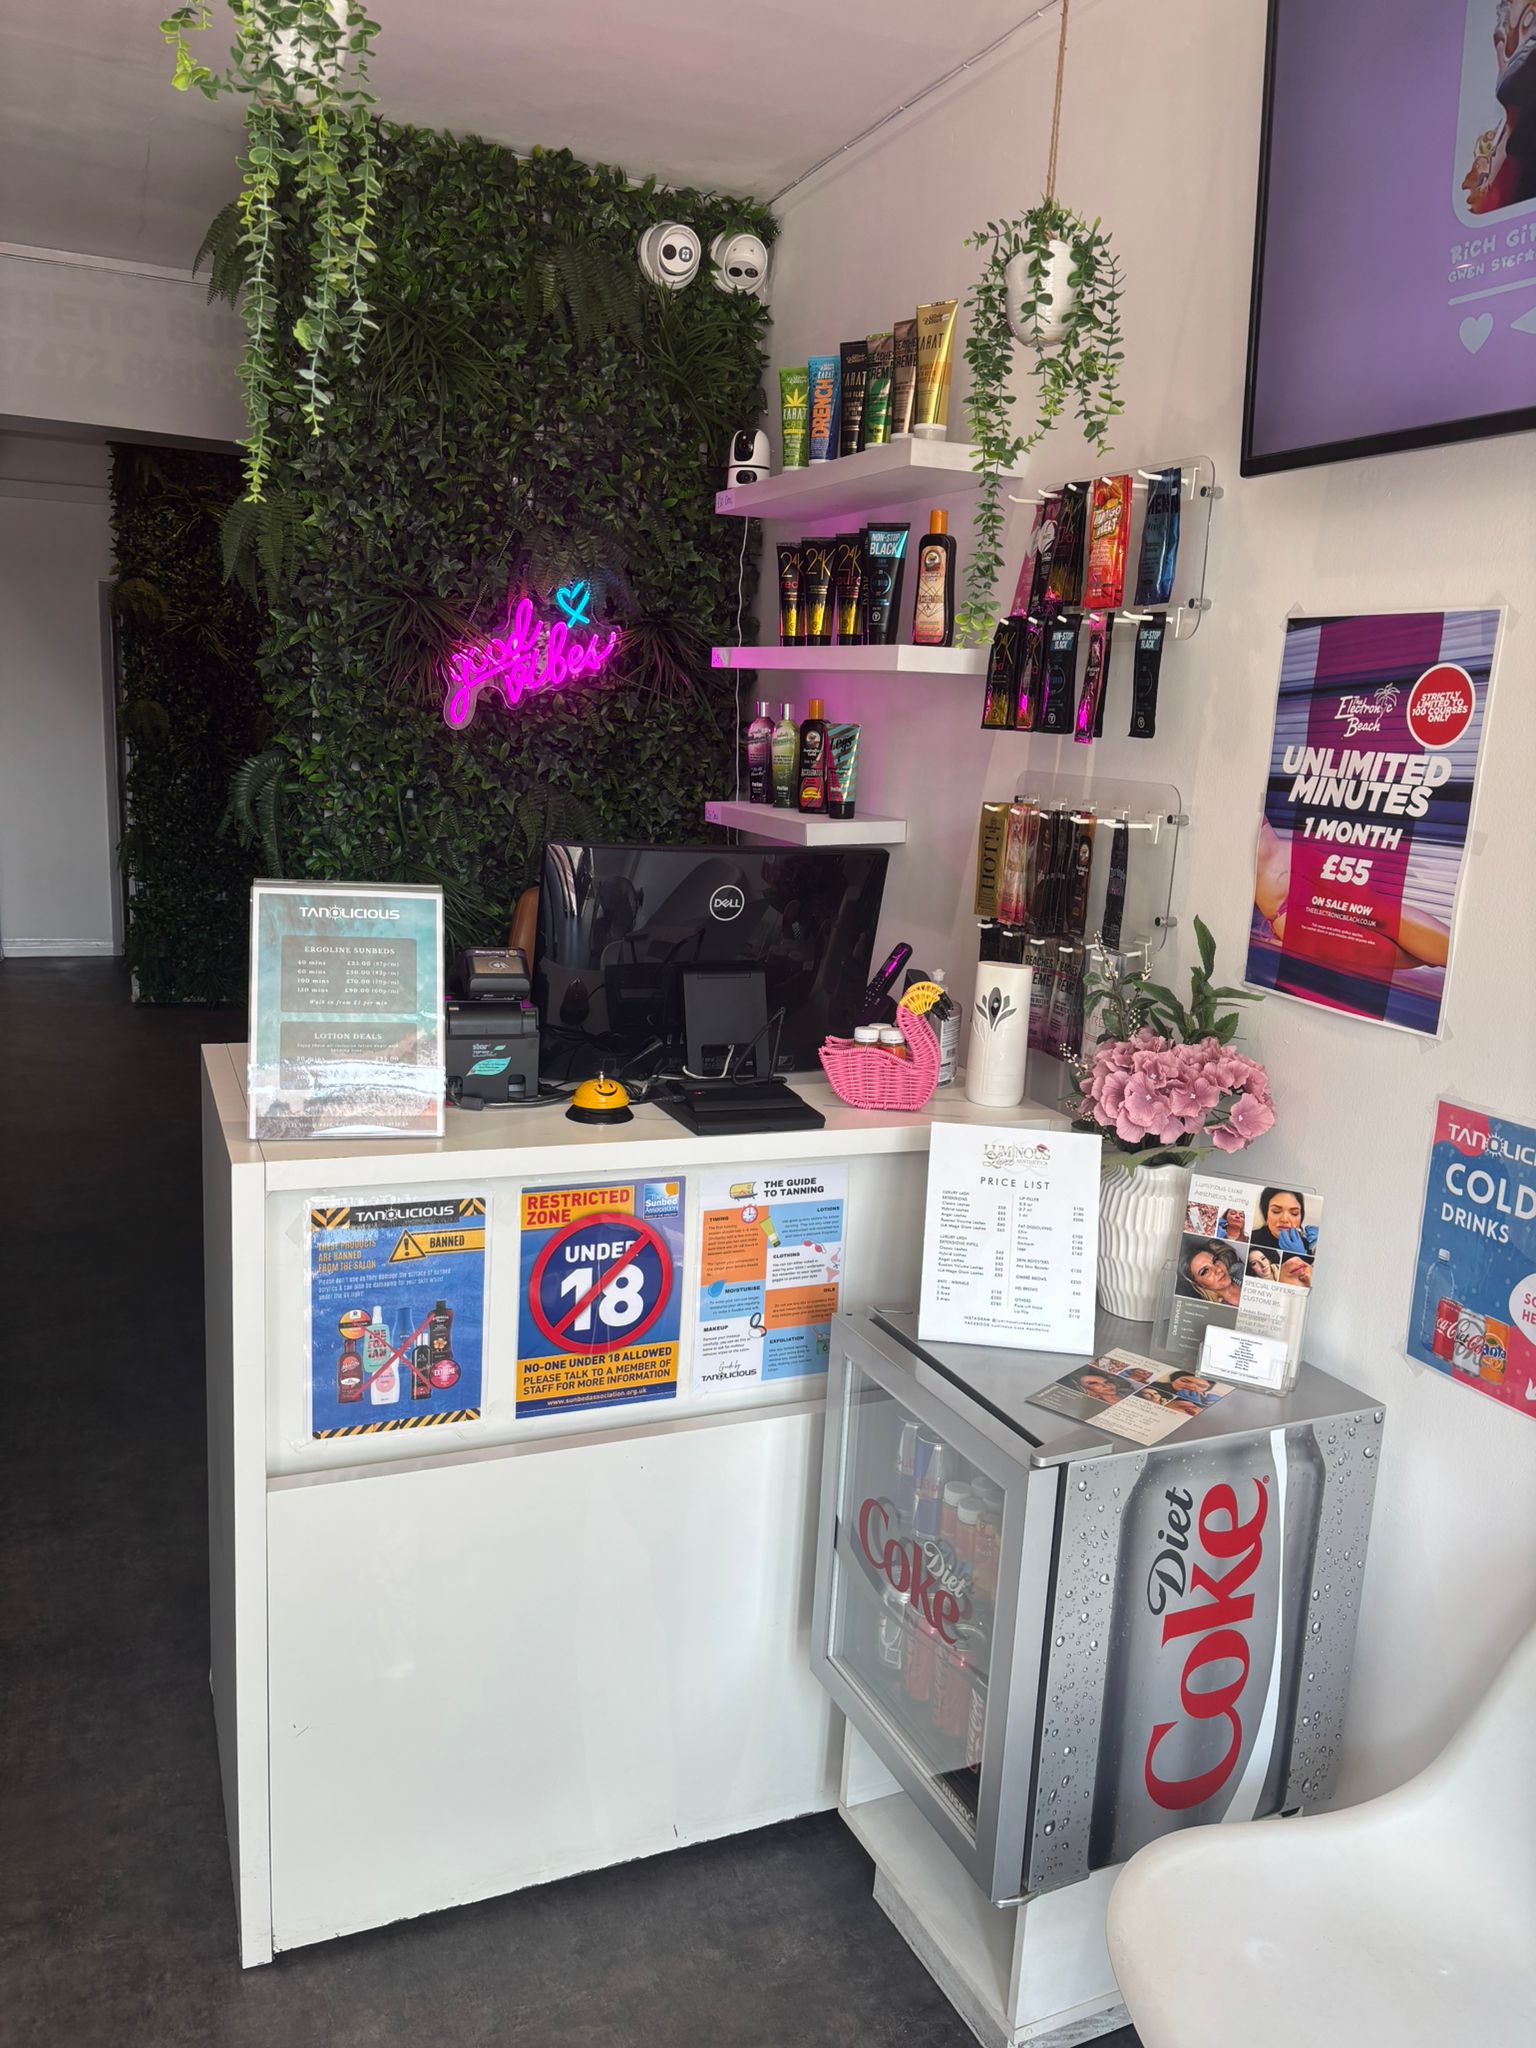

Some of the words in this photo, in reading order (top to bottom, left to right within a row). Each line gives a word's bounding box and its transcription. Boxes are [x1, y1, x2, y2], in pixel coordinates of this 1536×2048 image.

[811, 379, 834, 438] DRENCH
[1096, 518, 1118, 536] MELT
[871, 533, 901, 542] NON-STOP
[869, 543, 899, 555] BLACK
[806, 548, 836, 581] 24K
[1416, 700, 1449, 709] LIMITED
[1452, 698, 1464, 706] TO
[1421, 691, 1461, 701] STRICTLY
[1412, 707, 1426, 716] 100
[1428, 705, 1469, 715] COURSES
[1427, 713, 1450, 723] ONLY
[1343, 717, 1381, 737] Beach
[1282, 745, 1452, 787] UNLIMITED
[1288, 775, 1433, 818] MINUTES
[1303, 817, 1316, 838] 1
[1315, 818, 1403, 851] MONTH
[1320, 854, 1374, 887] £55
[714, 899, 740, 908] DELL
[1312, 896, 1326, 907] ON
[1325, 899, 1349, 912] SALE
[1348, 903, 1373, 916] NOW
[304, 946, 351, 954] ERGOLINE
[353, 947, 396, 955] SUNBEDS
[764, 1180, 784, 1188] THE
[786, 1177, 817, 1187] GUIDE
[764, 1189, 778, 1197] TO
[780, 1185, 824, 1196] TANNING
[980, 1176, 1017, 1188] PRICE
[1024, 1180, 1050, 1190] LIST
[1445, 1162, 1536, 1220] COLD
[527, 1189, 630, 1210] RESTRICTED
[356, 1205, 455, 1222] TANOLICIOUS
[526, 1209, 572, 1226] ZONE
[1441, 1202, 1510, 1244] DRINKS
[429, 1235, 465, 1248] BANNED
[318, 1253, 332, 1262] ARE
[334, 1251, 361, 1261] BANNED
[318, 1263, 338, 1273] FROM
[341, 1261, 352, 1271] THE
[354, 1260, 376, 1270] SALON
[725, 1286, 760, 1294] MOISTURISE
[1244, 1280, 1270, 1291] SPECIAL
[1244, 1287, 1257, 1295] FOR
[1258, 1289, 1272, 1297] NEW
[560, 1263, 644, 1331] 18
[769, 1336, 804, 1344] EXFOLIATION
[524, 1362, 566, 1374] NO-ONE
[569, 1355, 606, 1367] UNDER
[608, 1353, 620, 1363] 18
[622, 1347, 672, 1361] ALLOWED
[1483, 1344, 1506, 1359] anta
[523, 1373, 561, 1386] PLEASE
[565, 1370, 589, 1381] TALK
[592, 1368, 604, 1377] TO
[606, 1367, 613, 1375] A
[615, 1361, 657, 1374] MEMBER
[660, 1359, 672, 1368] OF
[523, 1384, 554, 1396] STAFF
[556, 1381, 575, 1391] FOR
[577, 1377, 605, 1390] MORE
[606, 1369, 671, 1385] INFORMATION
[547, 1388, 647, 1407] www.sunbedassociation.org.uk
[1147, 1486, 1193, 1616] Diet
[859, 1497, 960, 1645] Coke
[924, 1541, 964, 1598] Diet
[1145, 1477, 1268, 1811] Coke
[942, 1781, 972, 1821] HUSKY
